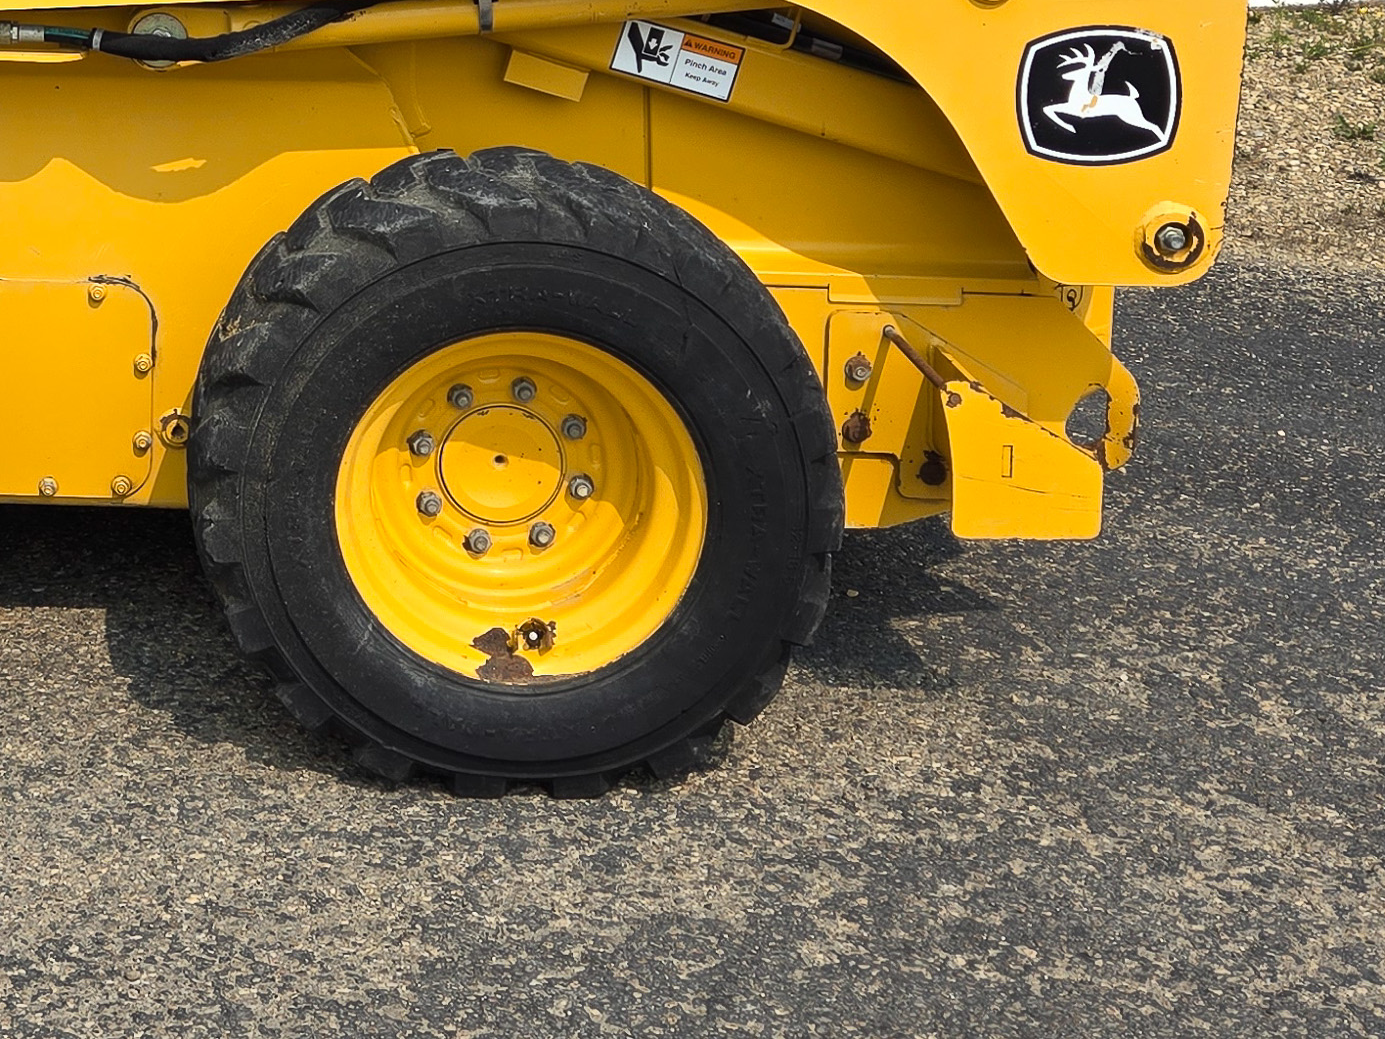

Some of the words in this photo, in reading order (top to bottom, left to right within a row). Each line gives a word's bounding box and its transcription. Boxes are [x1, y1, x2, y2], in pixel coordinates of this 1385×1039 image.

[694, 43, 736, 60] WARNING
[684, 58, 707, 72] Pinch
[709, 64, 727, 76] Area
[685, 72, 701, 82] Keep
[702, 77, 720, 87] Away
